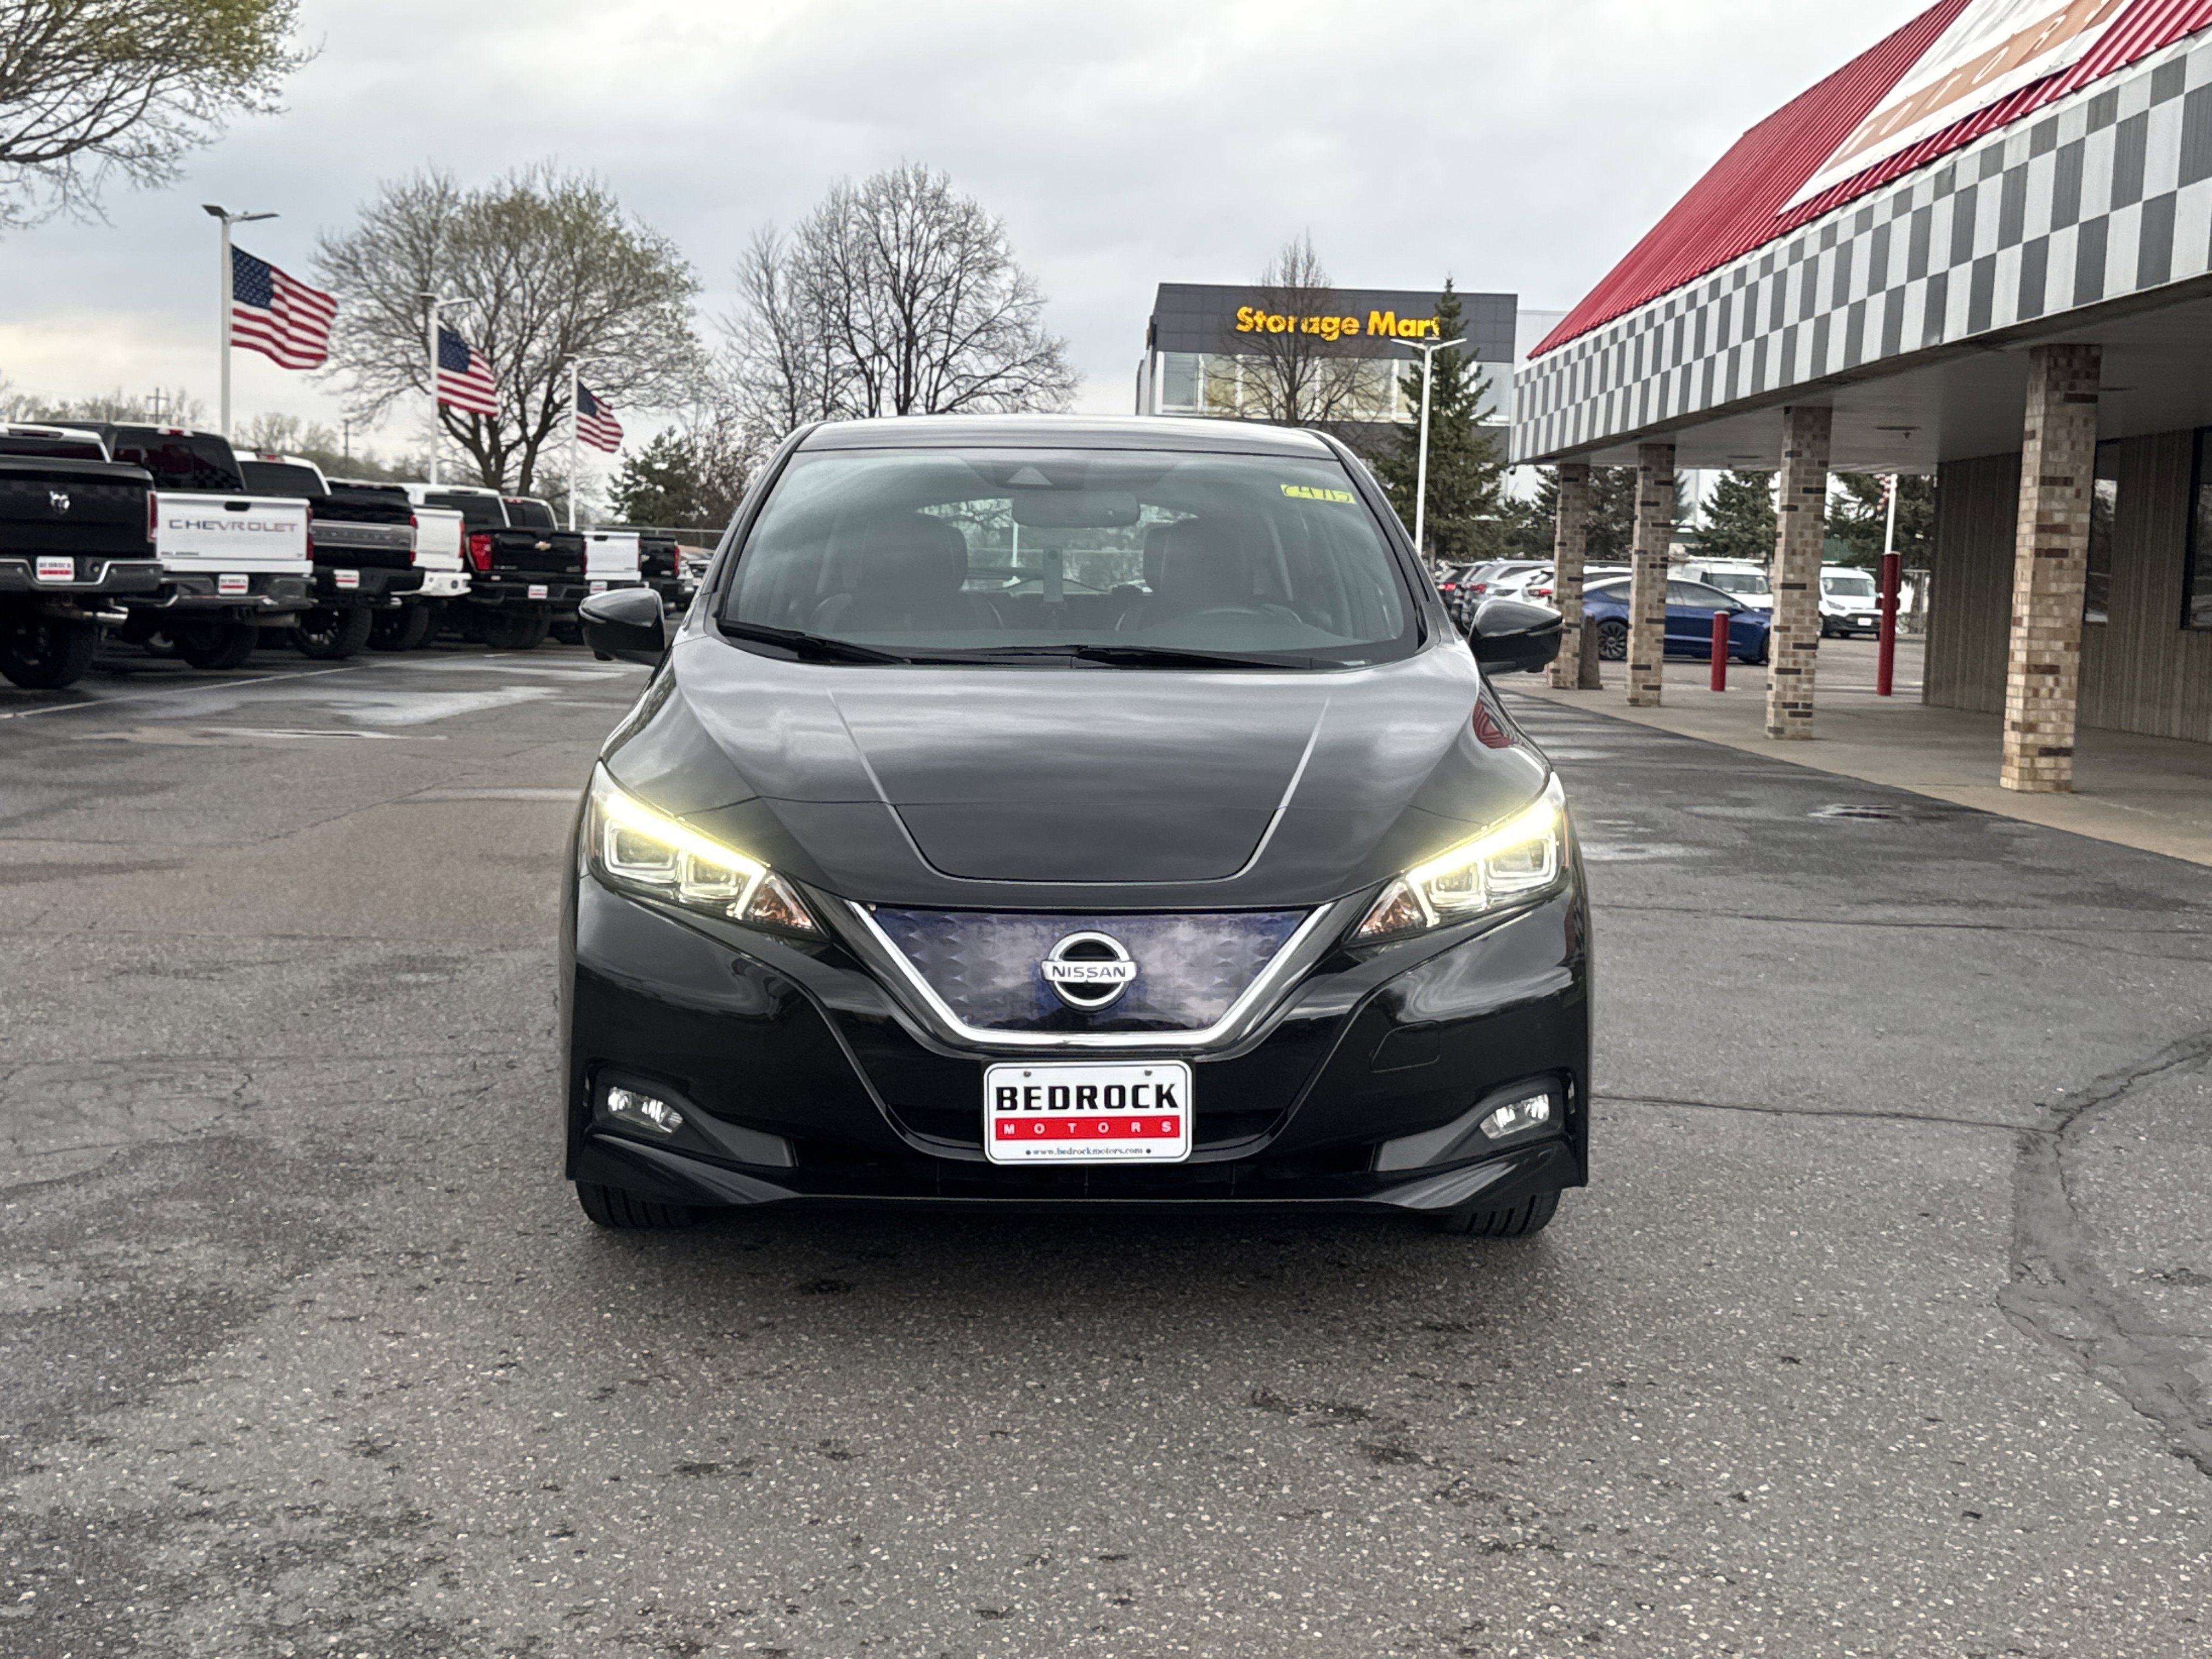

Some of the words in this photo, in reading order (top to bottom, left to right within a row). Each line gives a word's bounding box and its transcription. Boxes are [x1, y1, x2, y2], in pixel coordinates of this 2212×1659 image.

[1236, 306, 1360, 341] Storage
[169, 519, 298, 532] CHEVROLET
[1052, 966, 1126, 978] NISSAN
[996, 1084, 1179, 1111] BEDROCK
[1003, 1121, 1171, 1135] MOTORS
[1033, 1147, 1143, 1155] www.bedrockmotors.com
